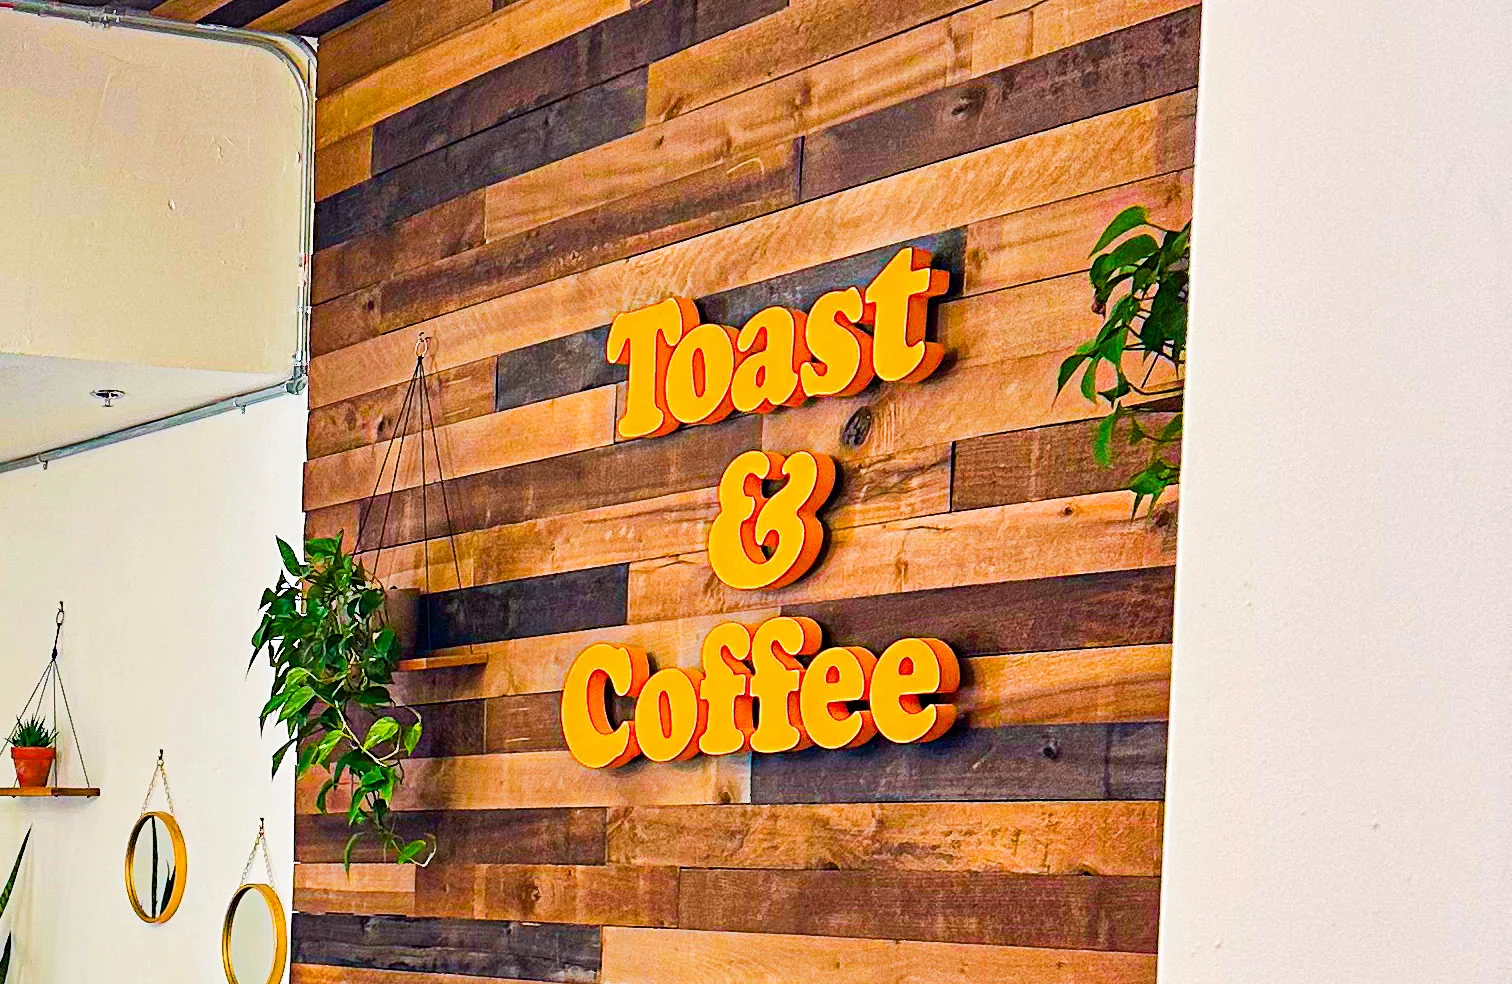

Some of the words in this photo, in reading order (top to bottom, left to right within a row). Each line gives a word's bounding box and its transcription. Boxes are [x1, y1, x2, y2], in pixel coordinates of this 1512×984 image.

[606, 246, 950, 439] Toast
[708, 450, 836, 590] &
[561, 616, 960, 770] Coffee
